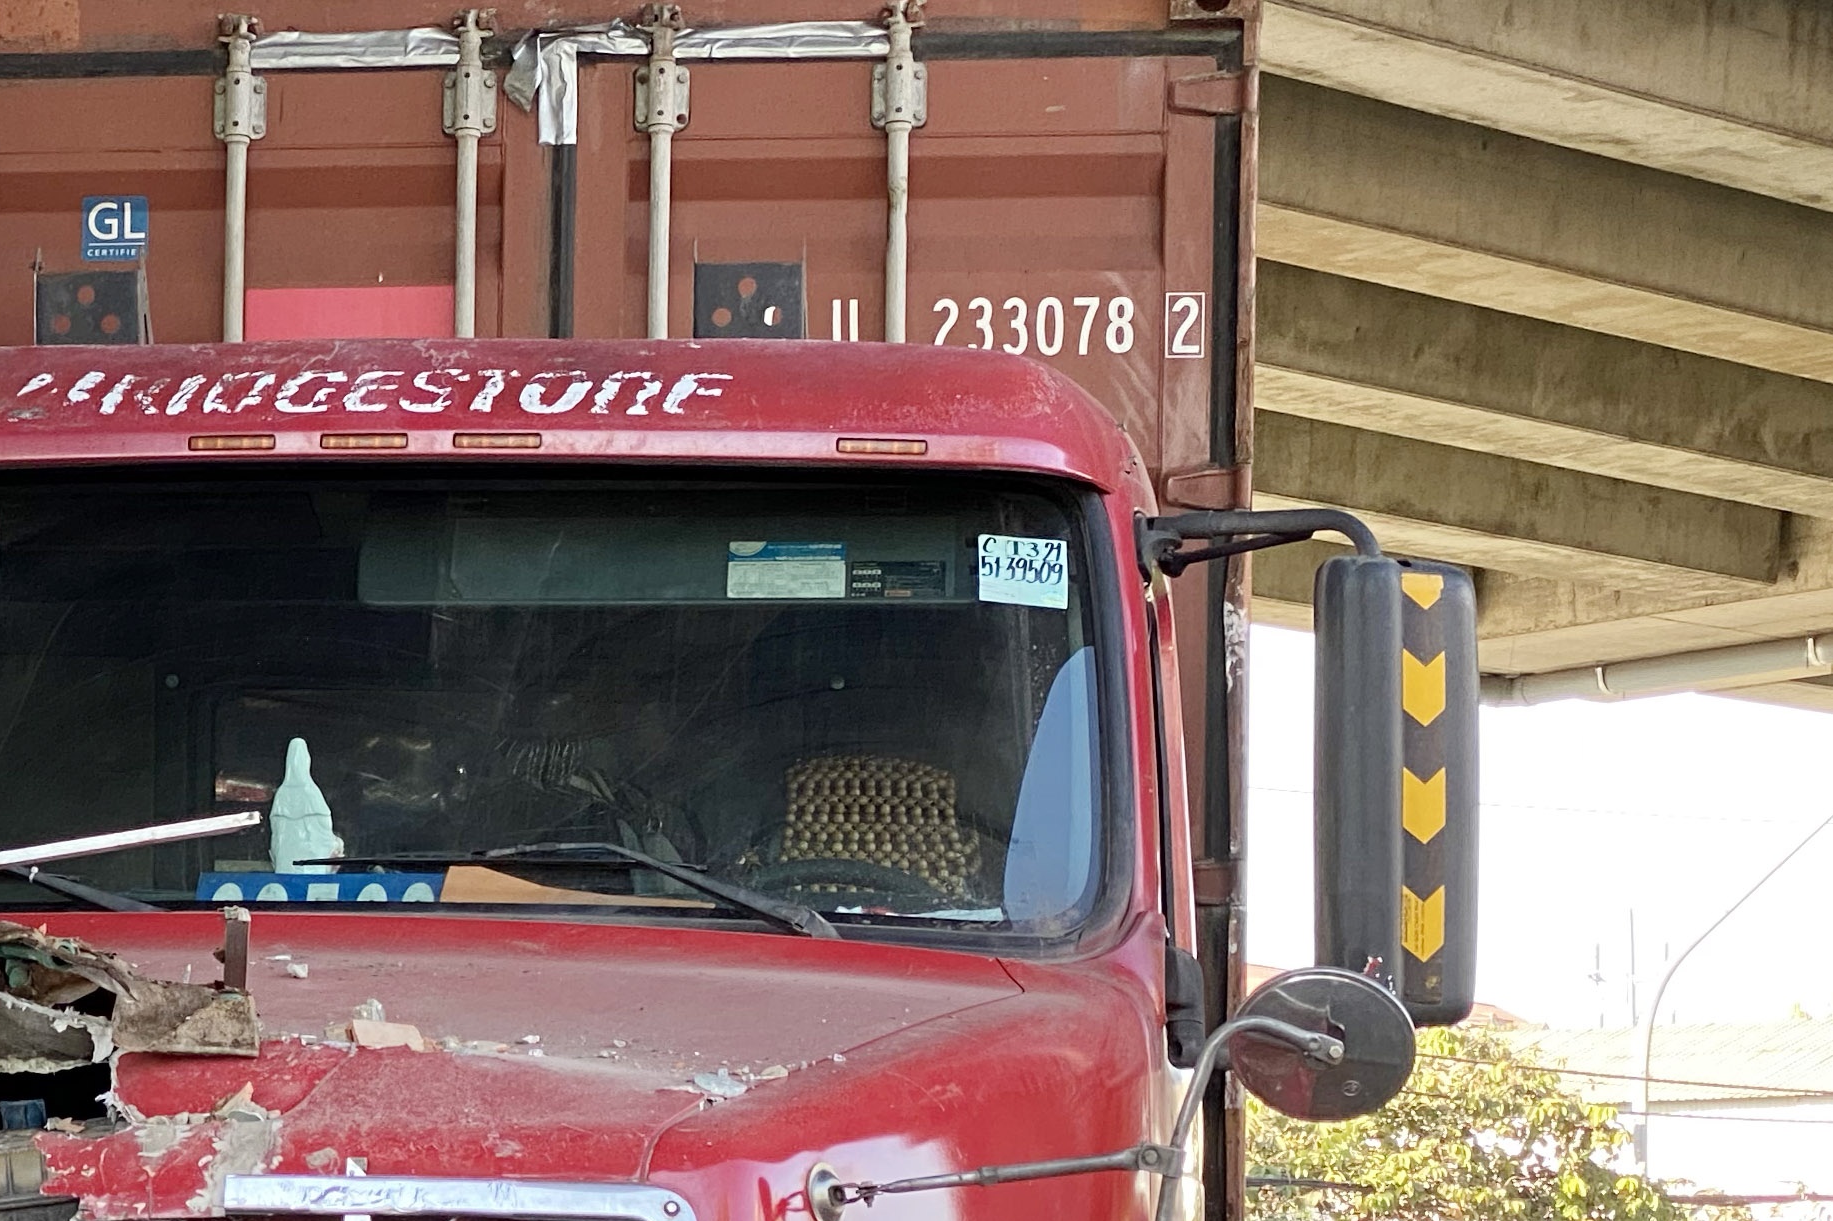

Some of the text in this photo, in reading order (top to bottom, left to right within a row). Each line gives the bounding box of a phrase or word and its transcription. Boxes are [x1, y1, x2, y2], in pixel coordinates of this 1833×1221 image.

[88, 201, 146, 240] GL
[87, 248, 139, 257] CERTIFIE
[932, 296, 1136, 356] 233078
[1171, 296, 1201, 354] 2
